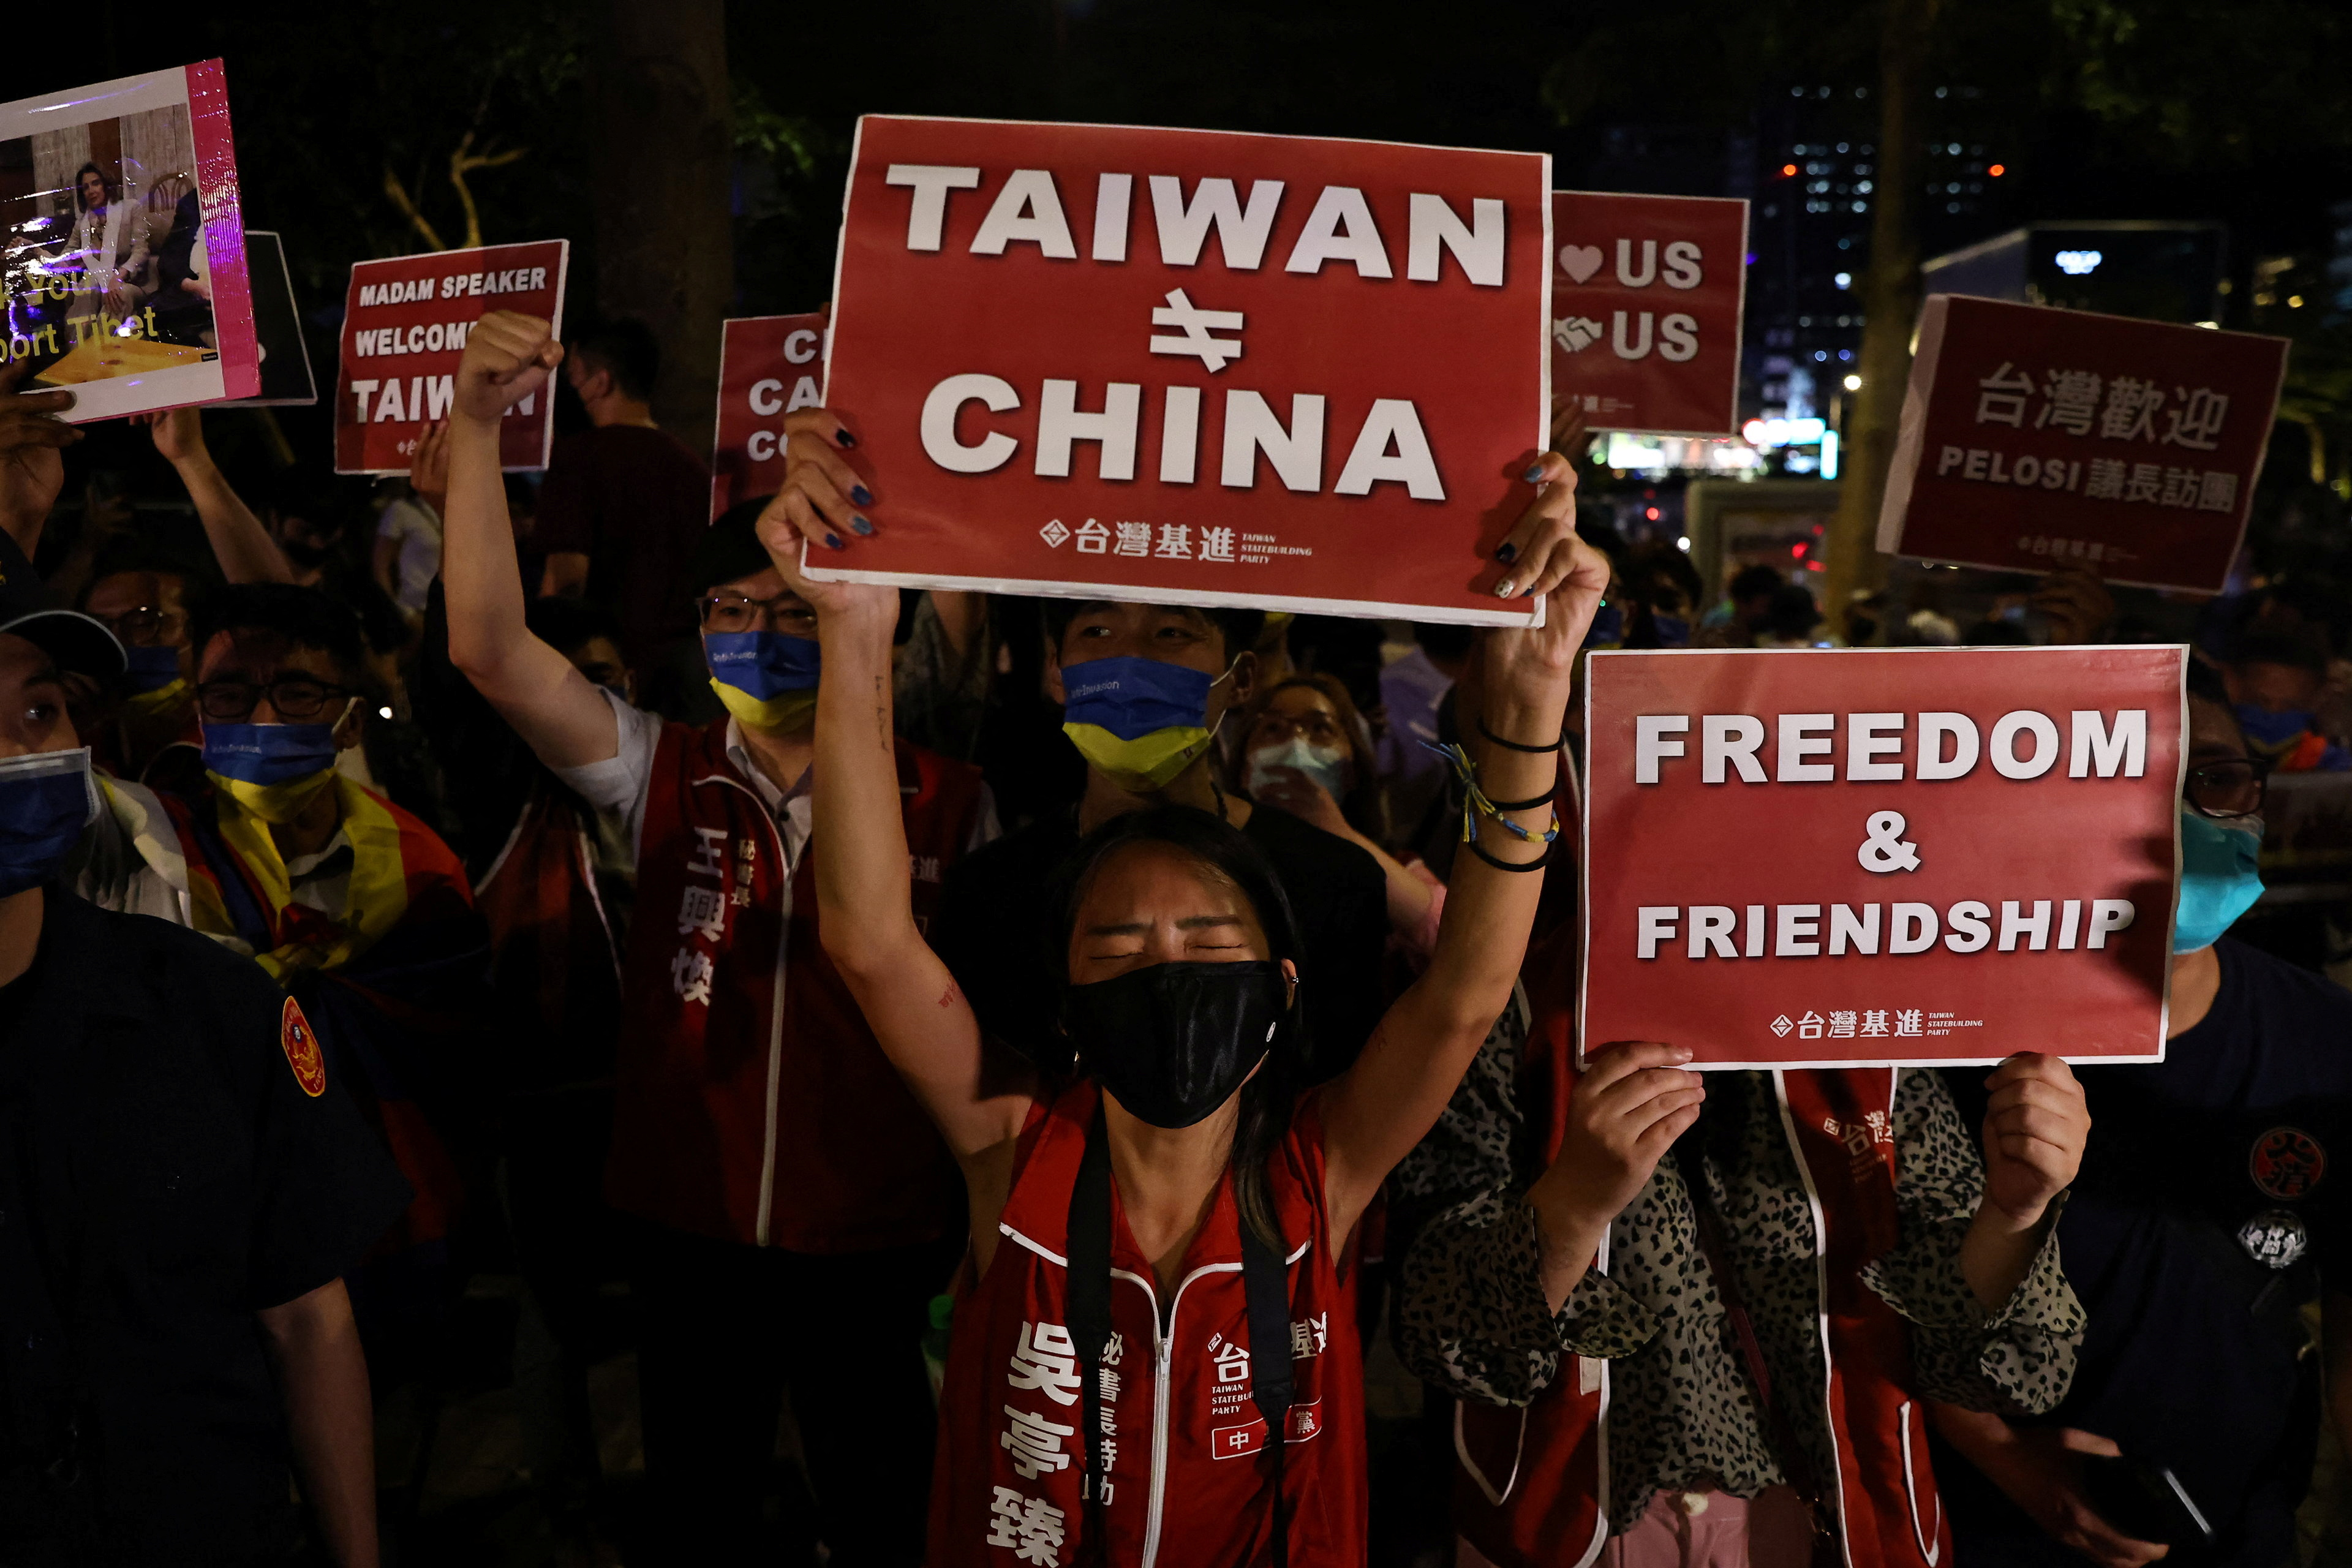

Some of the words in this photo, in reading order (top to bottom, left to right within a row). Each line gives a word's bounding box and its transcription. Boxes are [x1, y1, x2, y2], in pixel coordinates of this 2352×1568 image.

[886, 164, 1504, 286] TAIWAN
[360, 277, 435, 307] MADAM
[440, 266, 546, 299] SPEAKER
[1616, 238, 1703, 290] US
[66, 306, 159, 349] Tibet
[355, 320, 478, 358] WELCOM
[1611, 311, 1699, 362] US
[350, 374, 535, 424] TAIW
[1974, 361, 2230, 451] 台灣歡迎
[920, 374, 1446, 500] CHINA
[1937, 445, 2082, 491] PELOSI
[1074, 518, 1237, 562] 台灣基進
[1240, 543, 1313, 557] STATEBUILDING
[1240, 554, 1270, 564] PARTY
[1242, 532, 1276, 543] TAIWAN
[1636, 709, 2147, 784] FREEDOM
[1858, 810, 1921, 873] &
[1637, 899, 2136, 959] FRIENDSHIP
[1797, 1009, 1924, 1039] 台灣基進
[1212, 1383, 1244, 1394] TAIWAN
[1212, 1404, 1241, 1415] PARTY
[986, 1321, 1083, 1568] 吳亭臻
